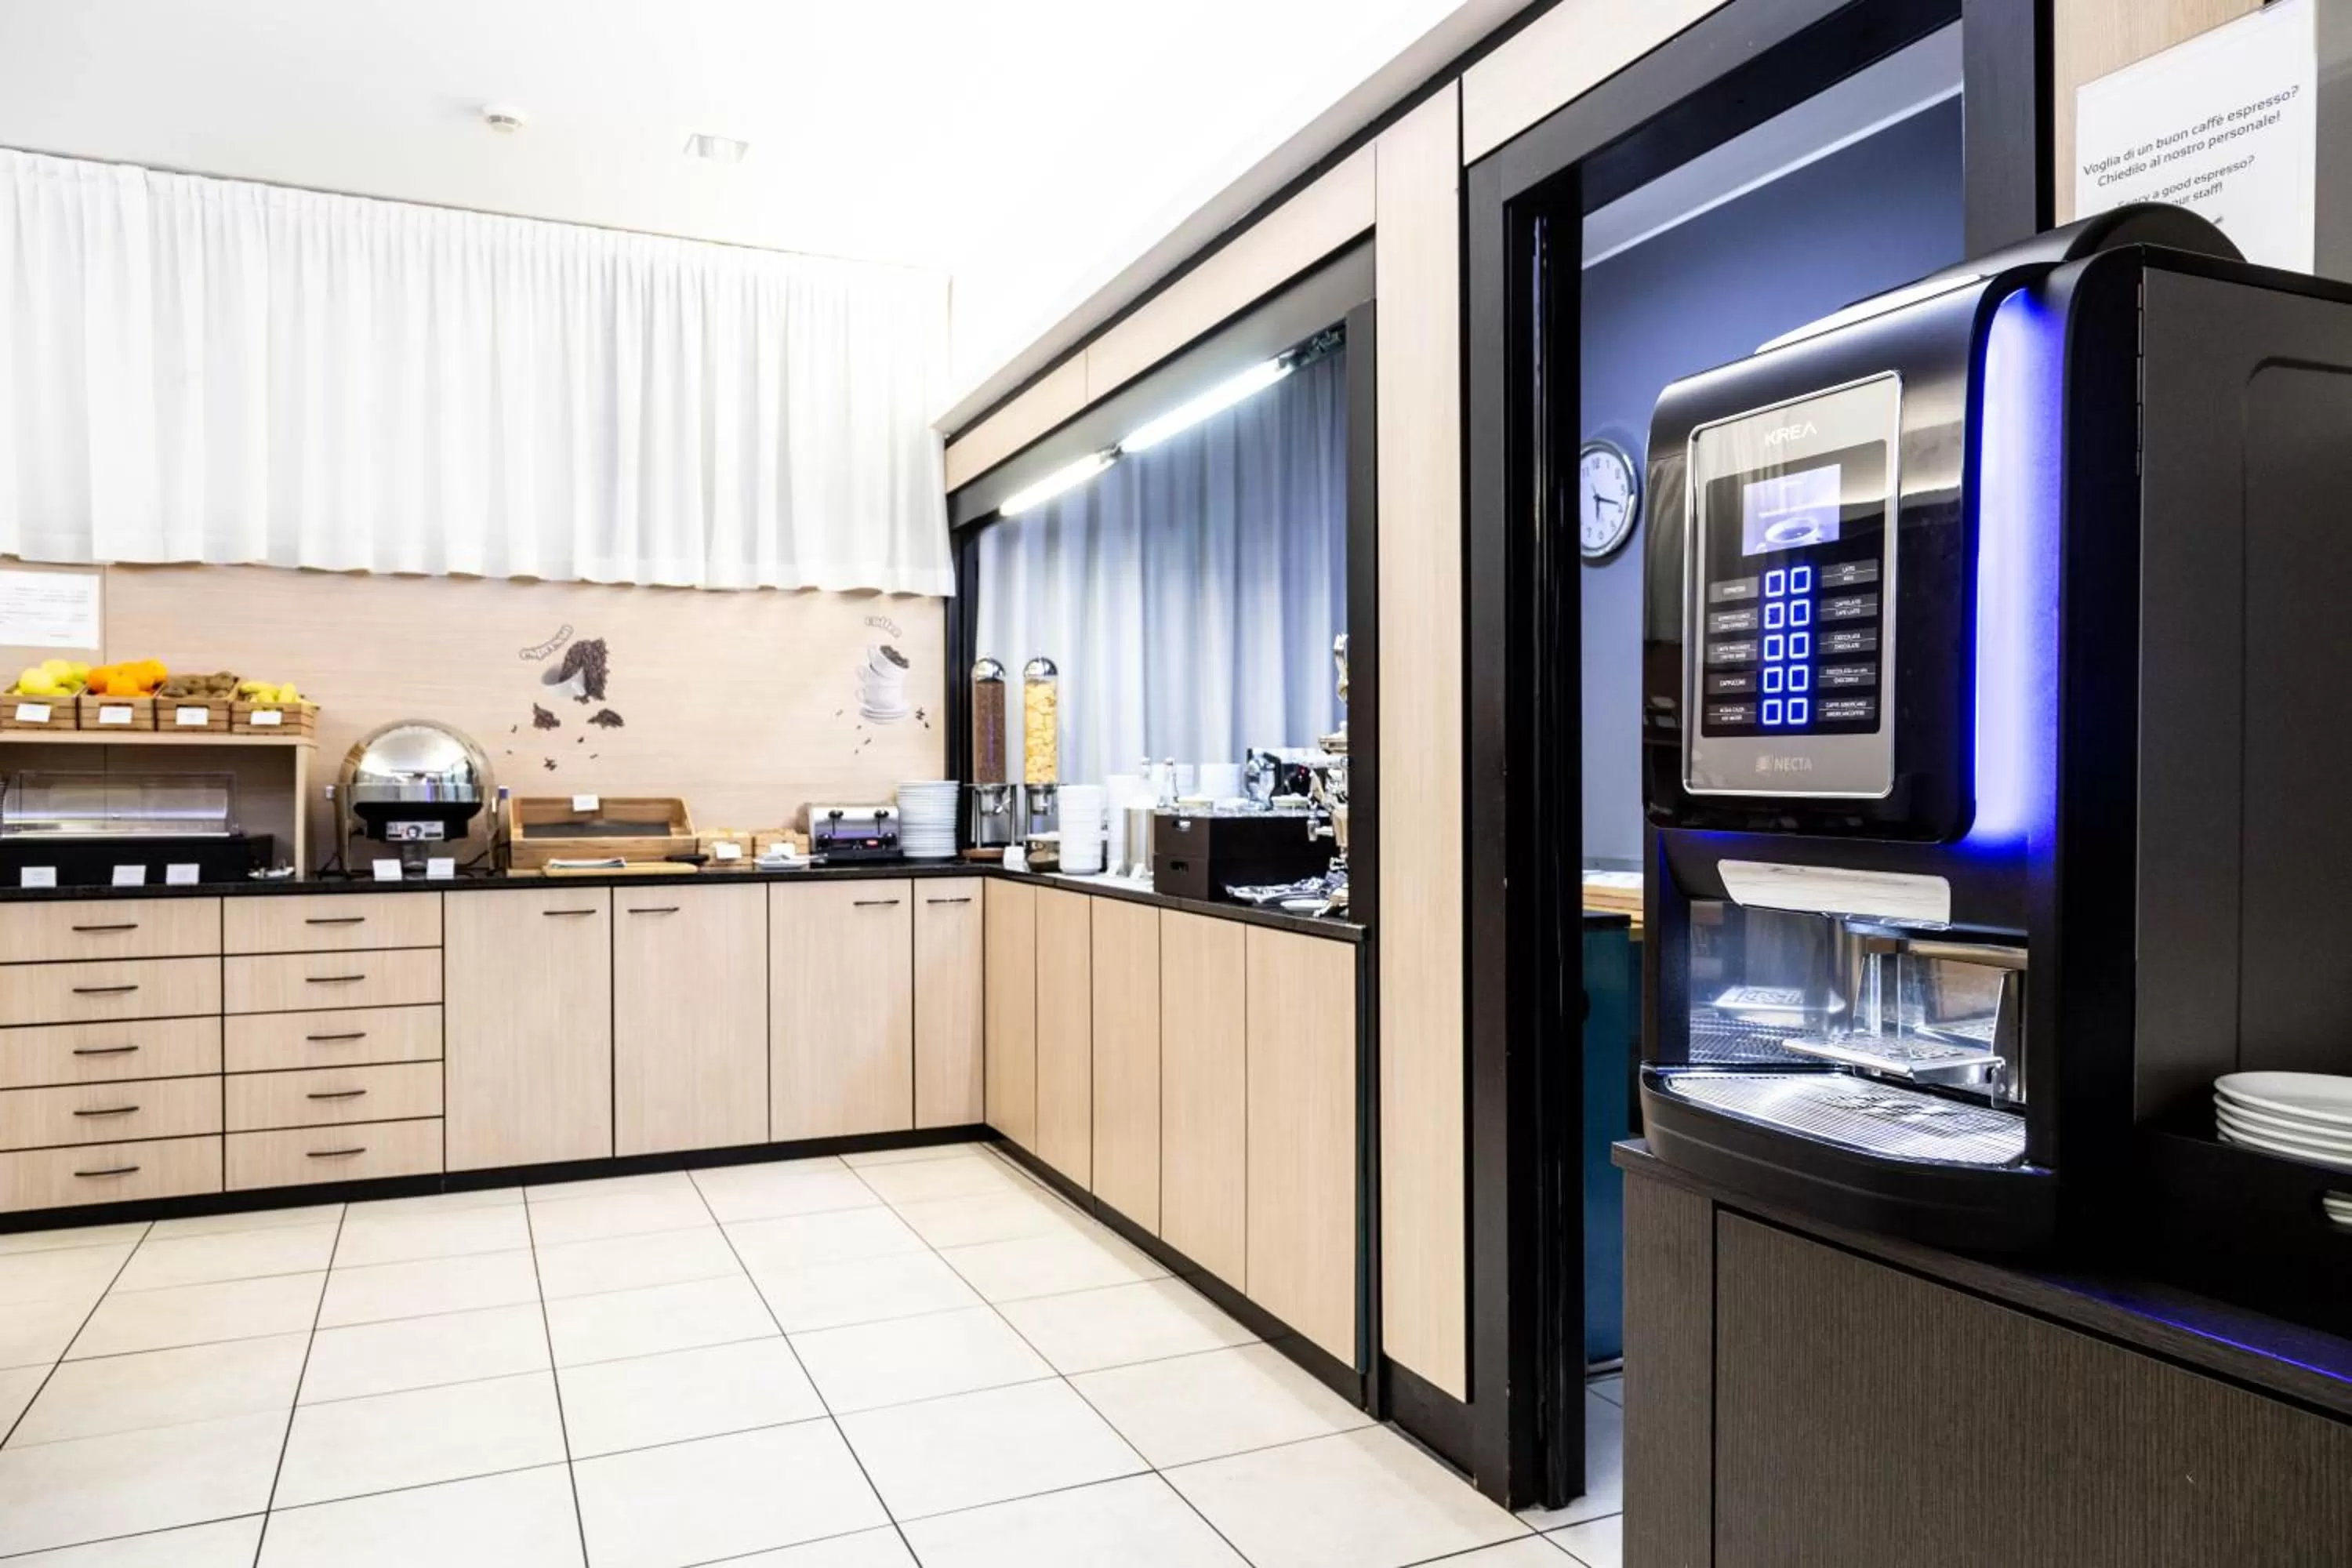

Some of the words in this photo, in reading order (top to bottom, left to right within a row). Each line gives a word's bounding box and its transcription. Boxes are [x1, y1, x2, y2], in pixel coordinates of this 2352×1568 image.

[2083, 156, 2121, 175] Voglia
[2123, 148, 2135, 161] di
[2137, 143, 2154, 156] un
[2156, 129, 2188, 148] buon
[2227, 84, 2299, 122] espresso?
[2097, 162, 2147, 187] Chiedilo
[2149, 155, 2161, 169] al
[2163, 140, 2205, 163] nostro
[2209, 109, 2281, 149] personale!
[2152, 191, 2160, 200] a
[2161, 178, 2191, 198] good
[2194, 154, 2256, 185] espresso?
[1774, 757, 1813, 772] NECTA
